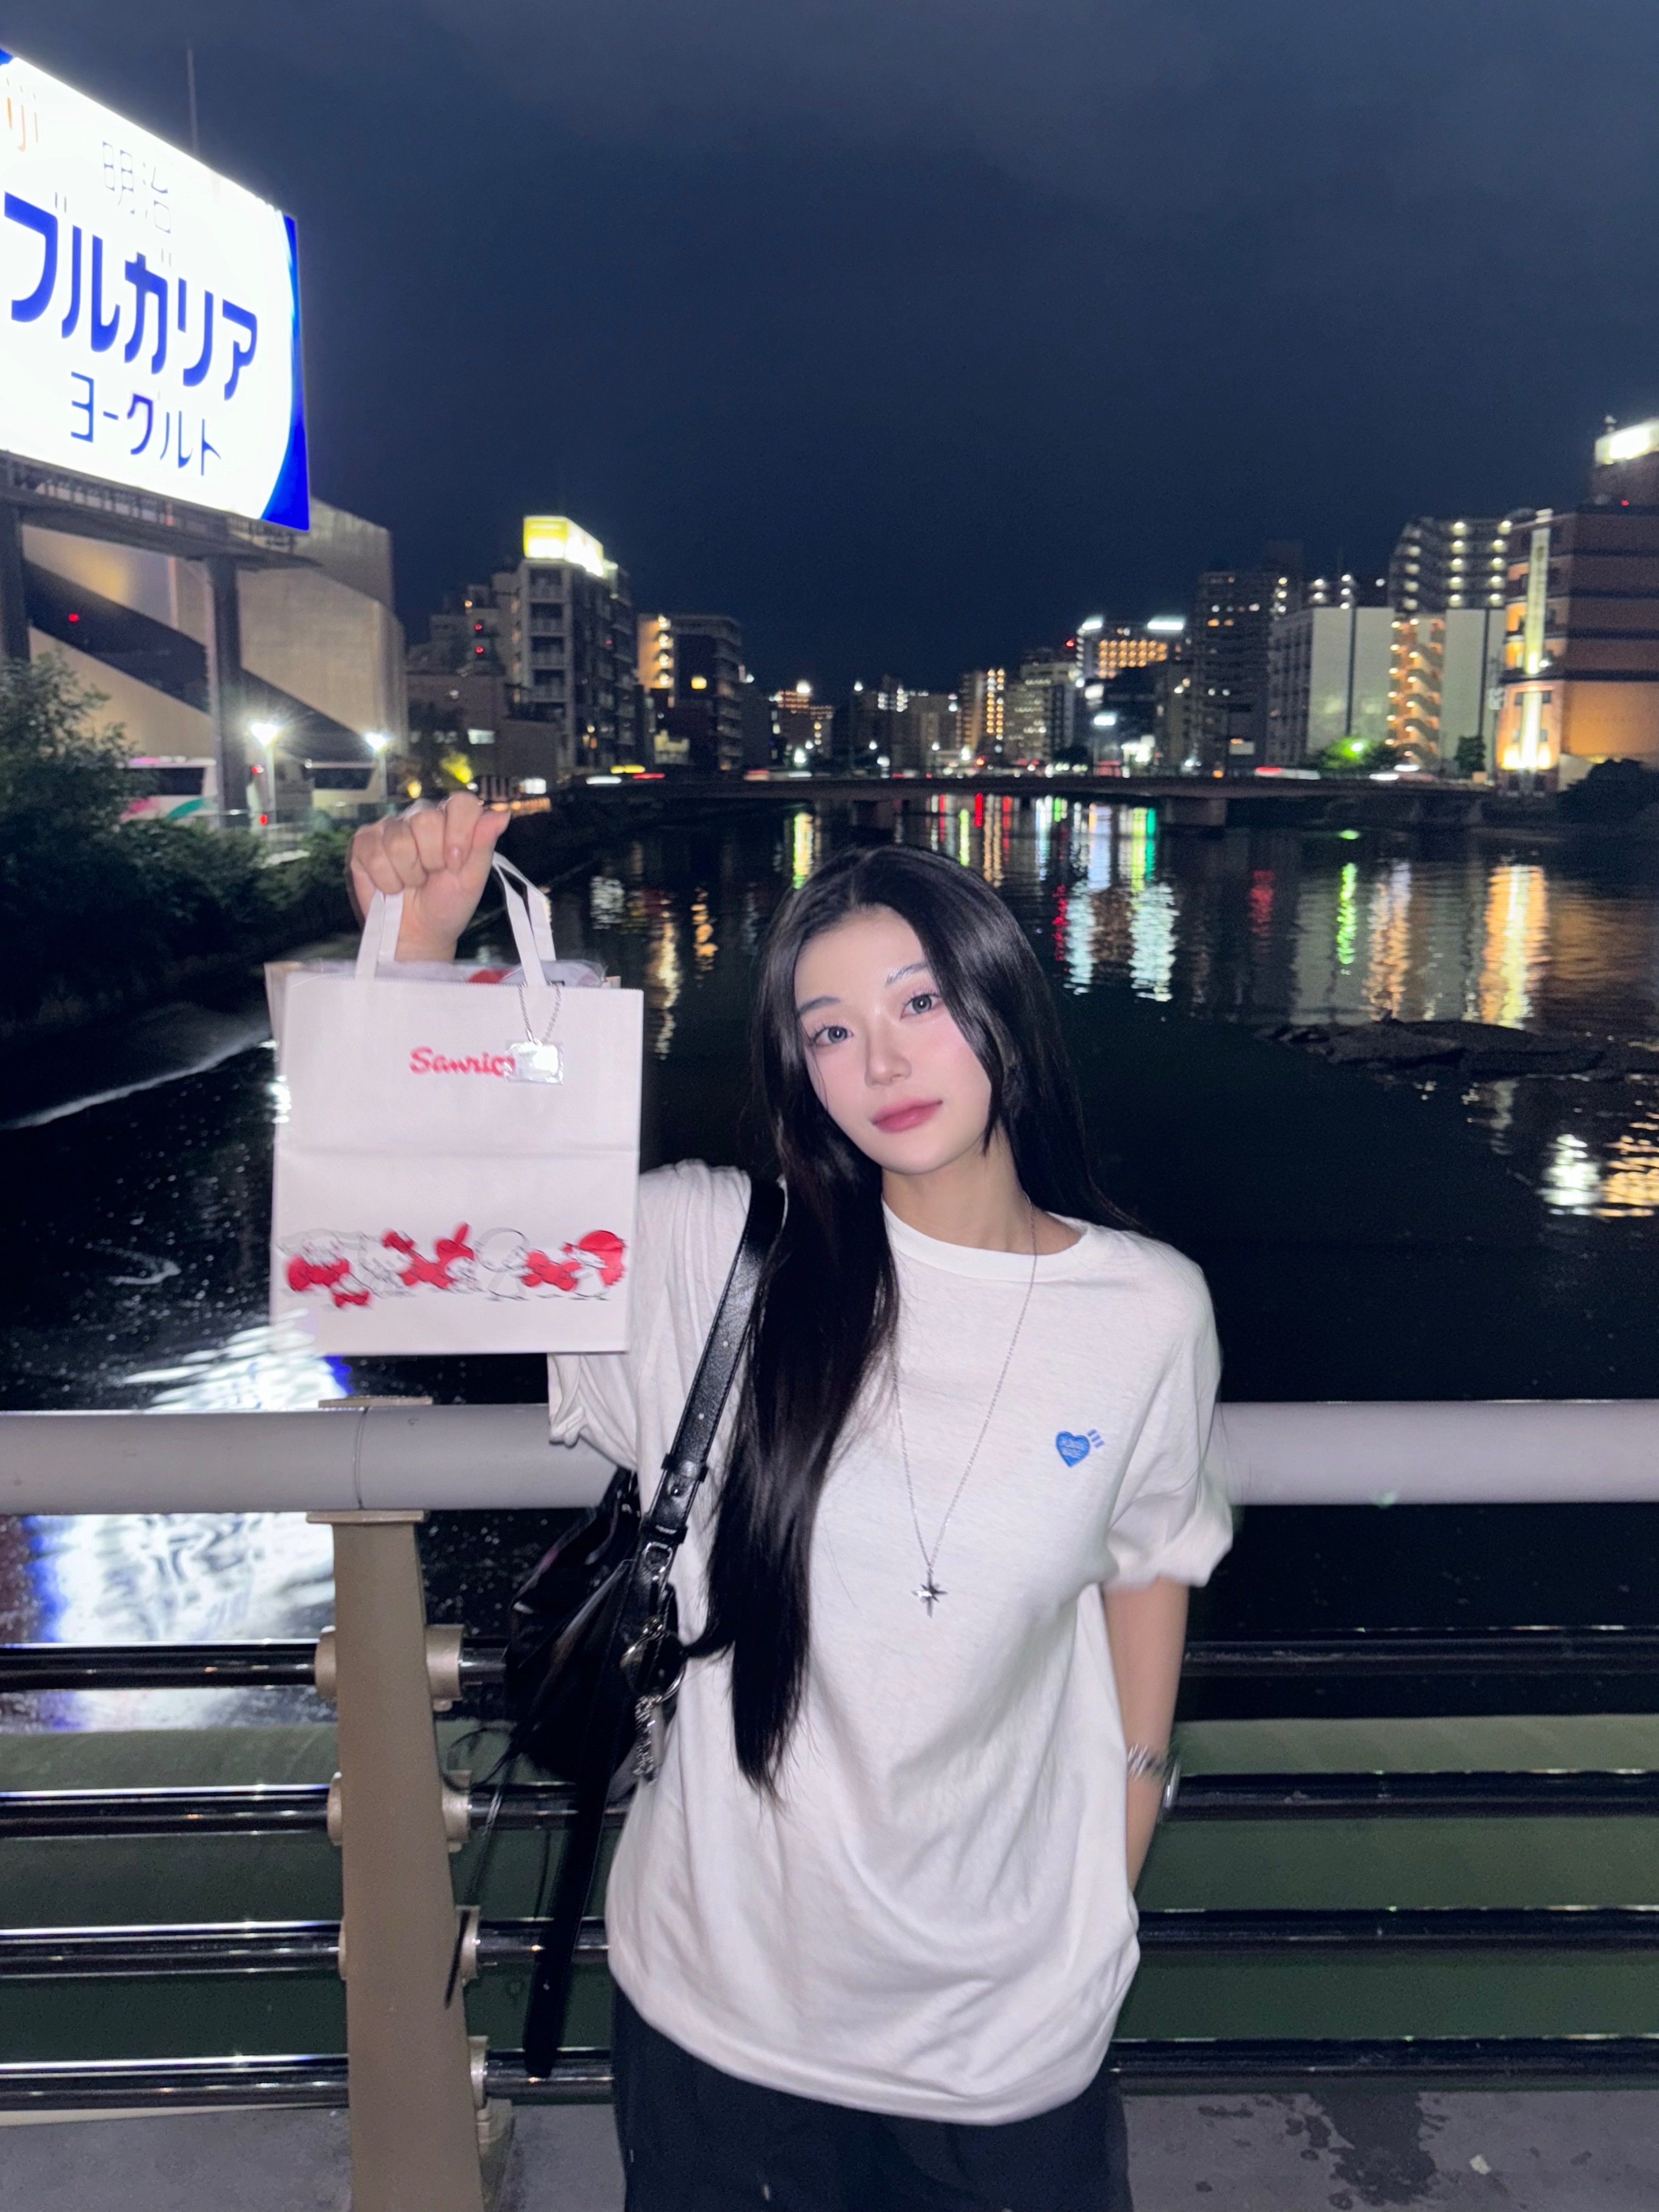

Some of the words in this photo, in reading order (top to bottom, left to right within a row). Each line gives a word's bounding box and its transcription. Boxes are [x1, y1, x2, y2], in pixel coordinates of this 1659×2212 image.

[103, 141, 171, 234] 明治
[4, 190, 258, 401] ブルガリア
[70, 371, 222, 476] ヨーグルト
